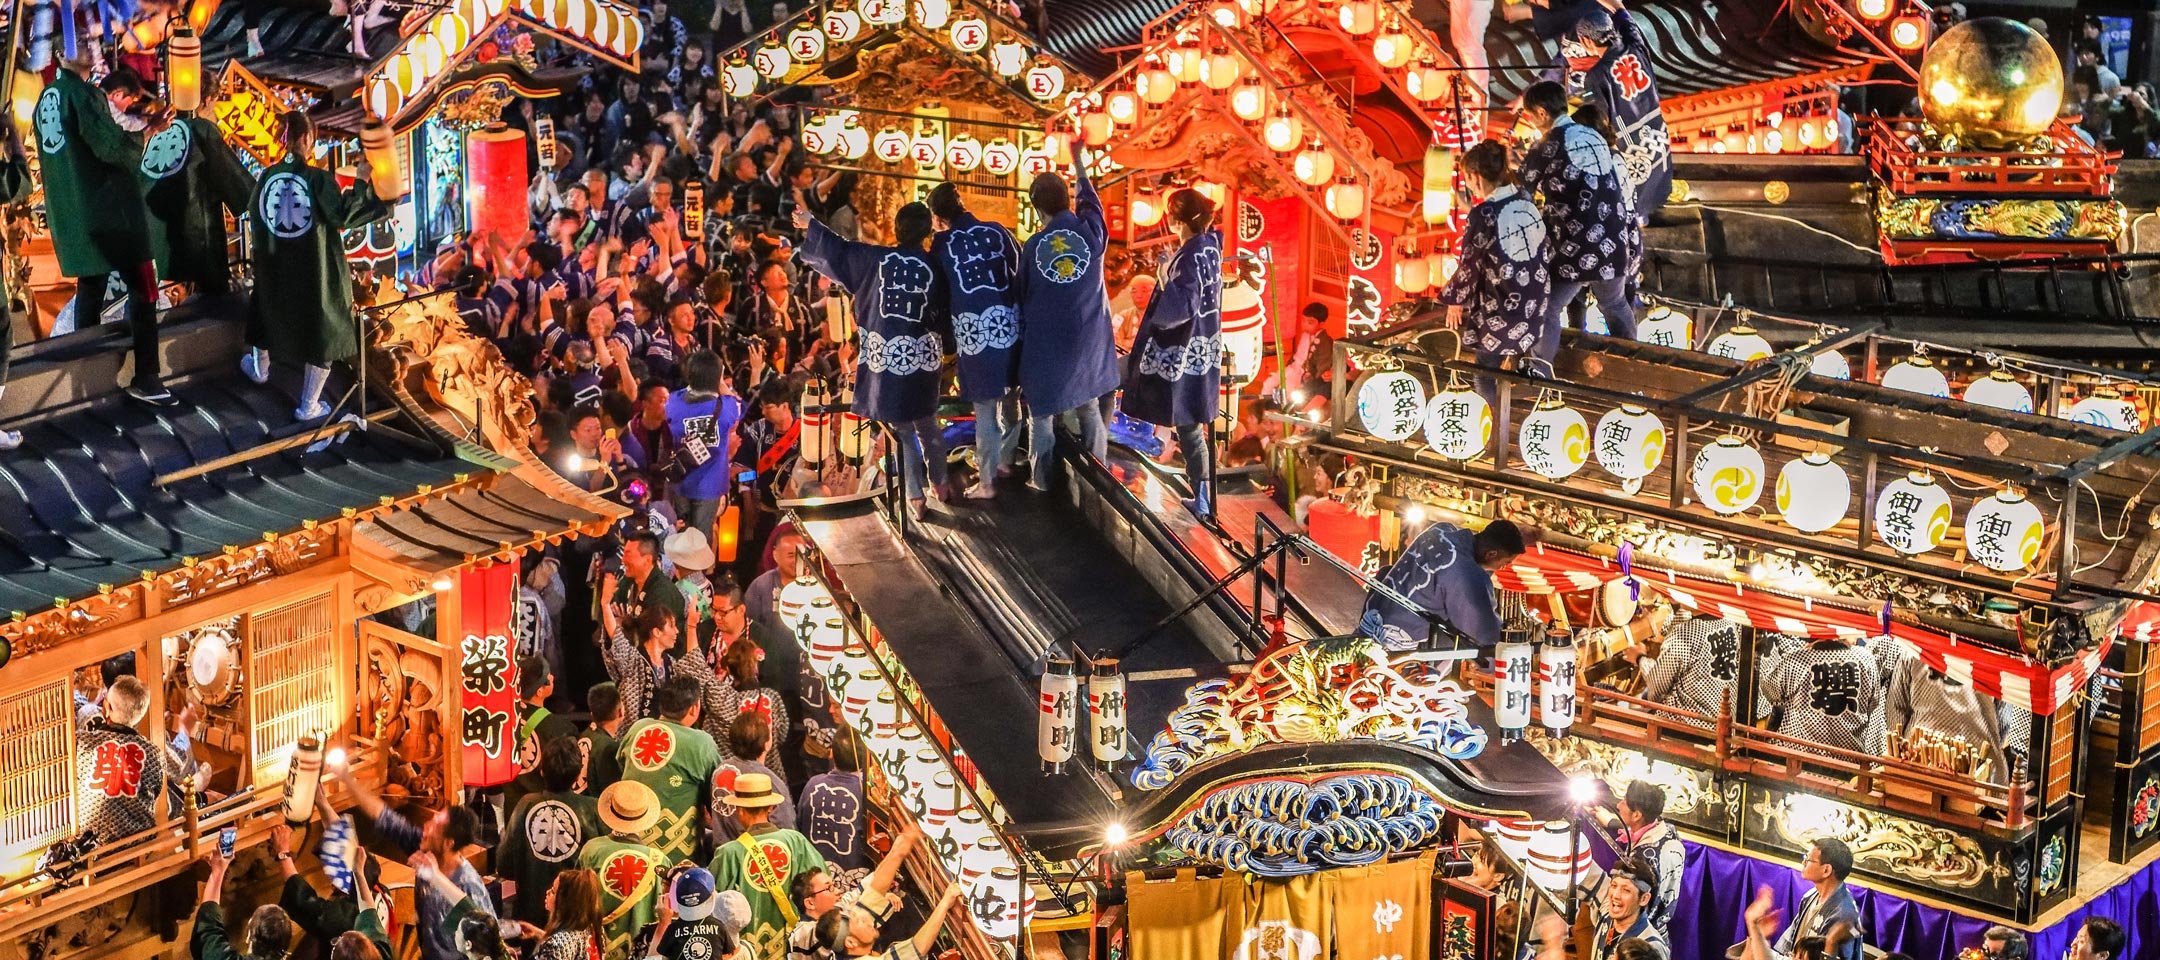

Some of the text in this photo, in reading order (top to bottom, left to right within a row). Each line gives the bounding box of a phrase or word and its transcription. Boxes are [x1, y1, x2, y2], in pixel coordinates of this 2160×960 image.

[964, 29, 979, 46] 上
[798, 40, 812, 56] 上
[1033, 77, 1047, 94] 上
[886, 143, 900, 157] 上
[917, 148, 930, 162] 上
[953, 152, 966, 166] 上
[990, 154, 1004, 169] 上
[1506, 656, 1531, 716] 仲町
[1550, 656, 1577, 718] 仲町
[1051, 690, 1078, 753] 仲町
[1098, 690, 1125, 752] 仲町
